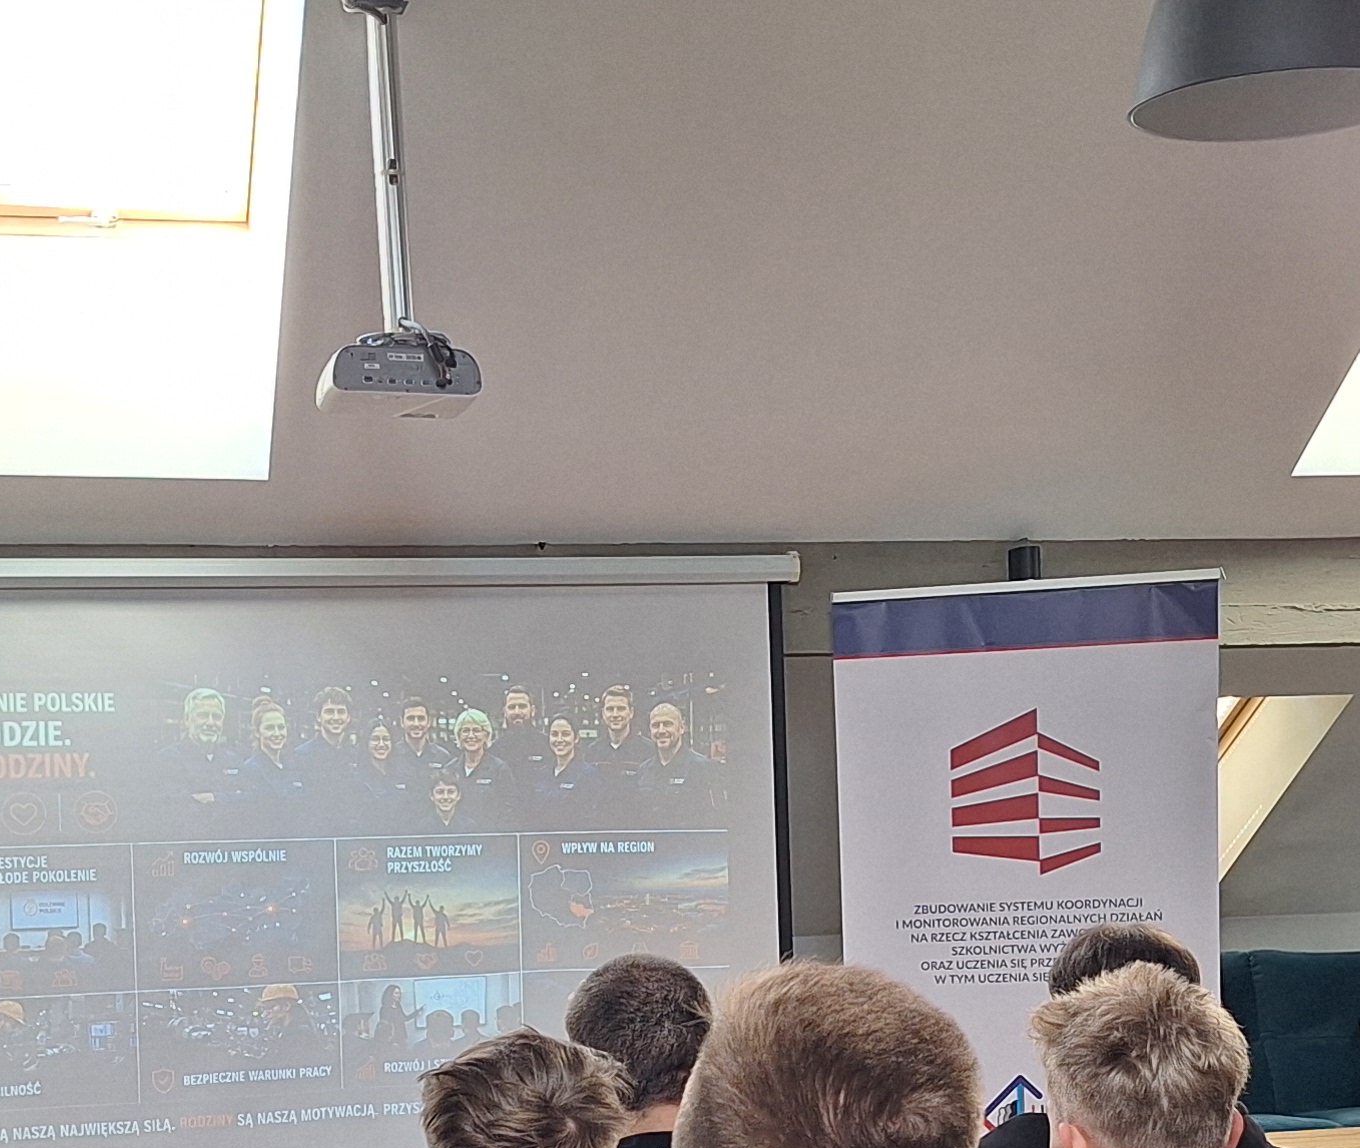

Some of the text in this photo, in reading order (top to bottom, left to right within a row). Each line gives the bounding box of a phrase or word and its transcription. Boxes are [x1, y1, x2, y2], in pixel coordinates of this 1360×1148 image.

[33, 691, 116, 712] POLSKIE
[386, 844, 483, 858] RAZEM TWORZYMY
[561, 841, 655, 854] WPŁYW NA REGION
[183, 847, 287, 864] ROZWÓJ WSPÓLNIE
[387, 857, 452, 874] PRZYSZŁOŚĆ
[32, 868, 98, 883] POKOLENIE
[914, 897, 1143, 915] ZBUDOWANIE SYSTEMU KOORDYNACJI
[895, 909, 1163, 929] I MONITOROWANIA REGIONALNYCH DZIAŁAŃ
[910, 933, 928, 943] NA
[931, 931, 967, 942] RZECZ
[970, 930, 1049, 942] KSZTAŁCENIA
[951, 944, 1037, 956] SZKOLNICTWA
[921, 961, 953, 971] ORAZ
[956, 959, 1008, 970] UCZENIA
[1010, 958, 1027, 970] SIĘ
[934, 974, 946, 984] W
[949, 974, 975, 984] TYM
[978, 972, 1030, 984] UCZENIA
[384, 1058, 425, 1073] ROZWÓJ
[183, 1065, 333, 1087] BEZPIECZNE WARUNKI PRACY
[13, 1125, 56, 1141] NASZĄ
[59, 1120, 140, 1138] NAJWIĘKSZĄ
[237, 1113, 254, 1129] SĄ
[257, 1110, 297, 1125] NASZĄ
